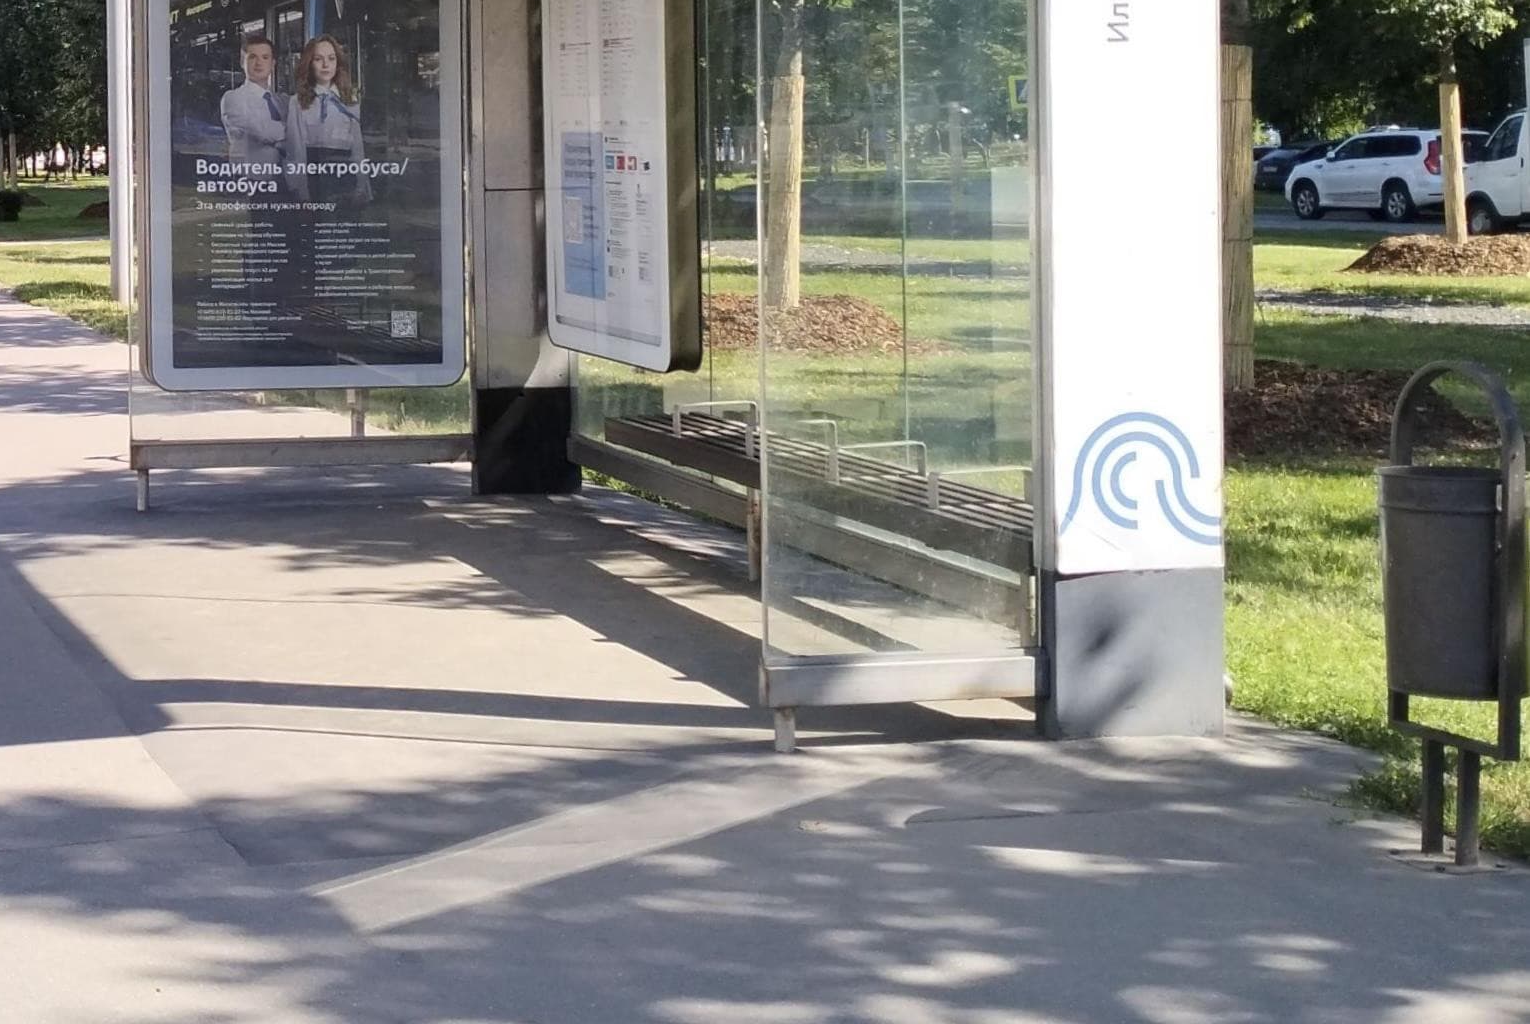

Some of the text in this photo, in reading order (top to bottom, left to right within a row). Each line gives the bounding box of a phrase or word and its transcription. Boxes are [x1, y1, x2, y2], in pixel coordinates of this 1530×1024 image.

[196, 157, 409, 178] Водитель электробуса/
[196, 177, 278, 196] автобуса
[196, 201, 337, 212] Эта профессия нужна городу
